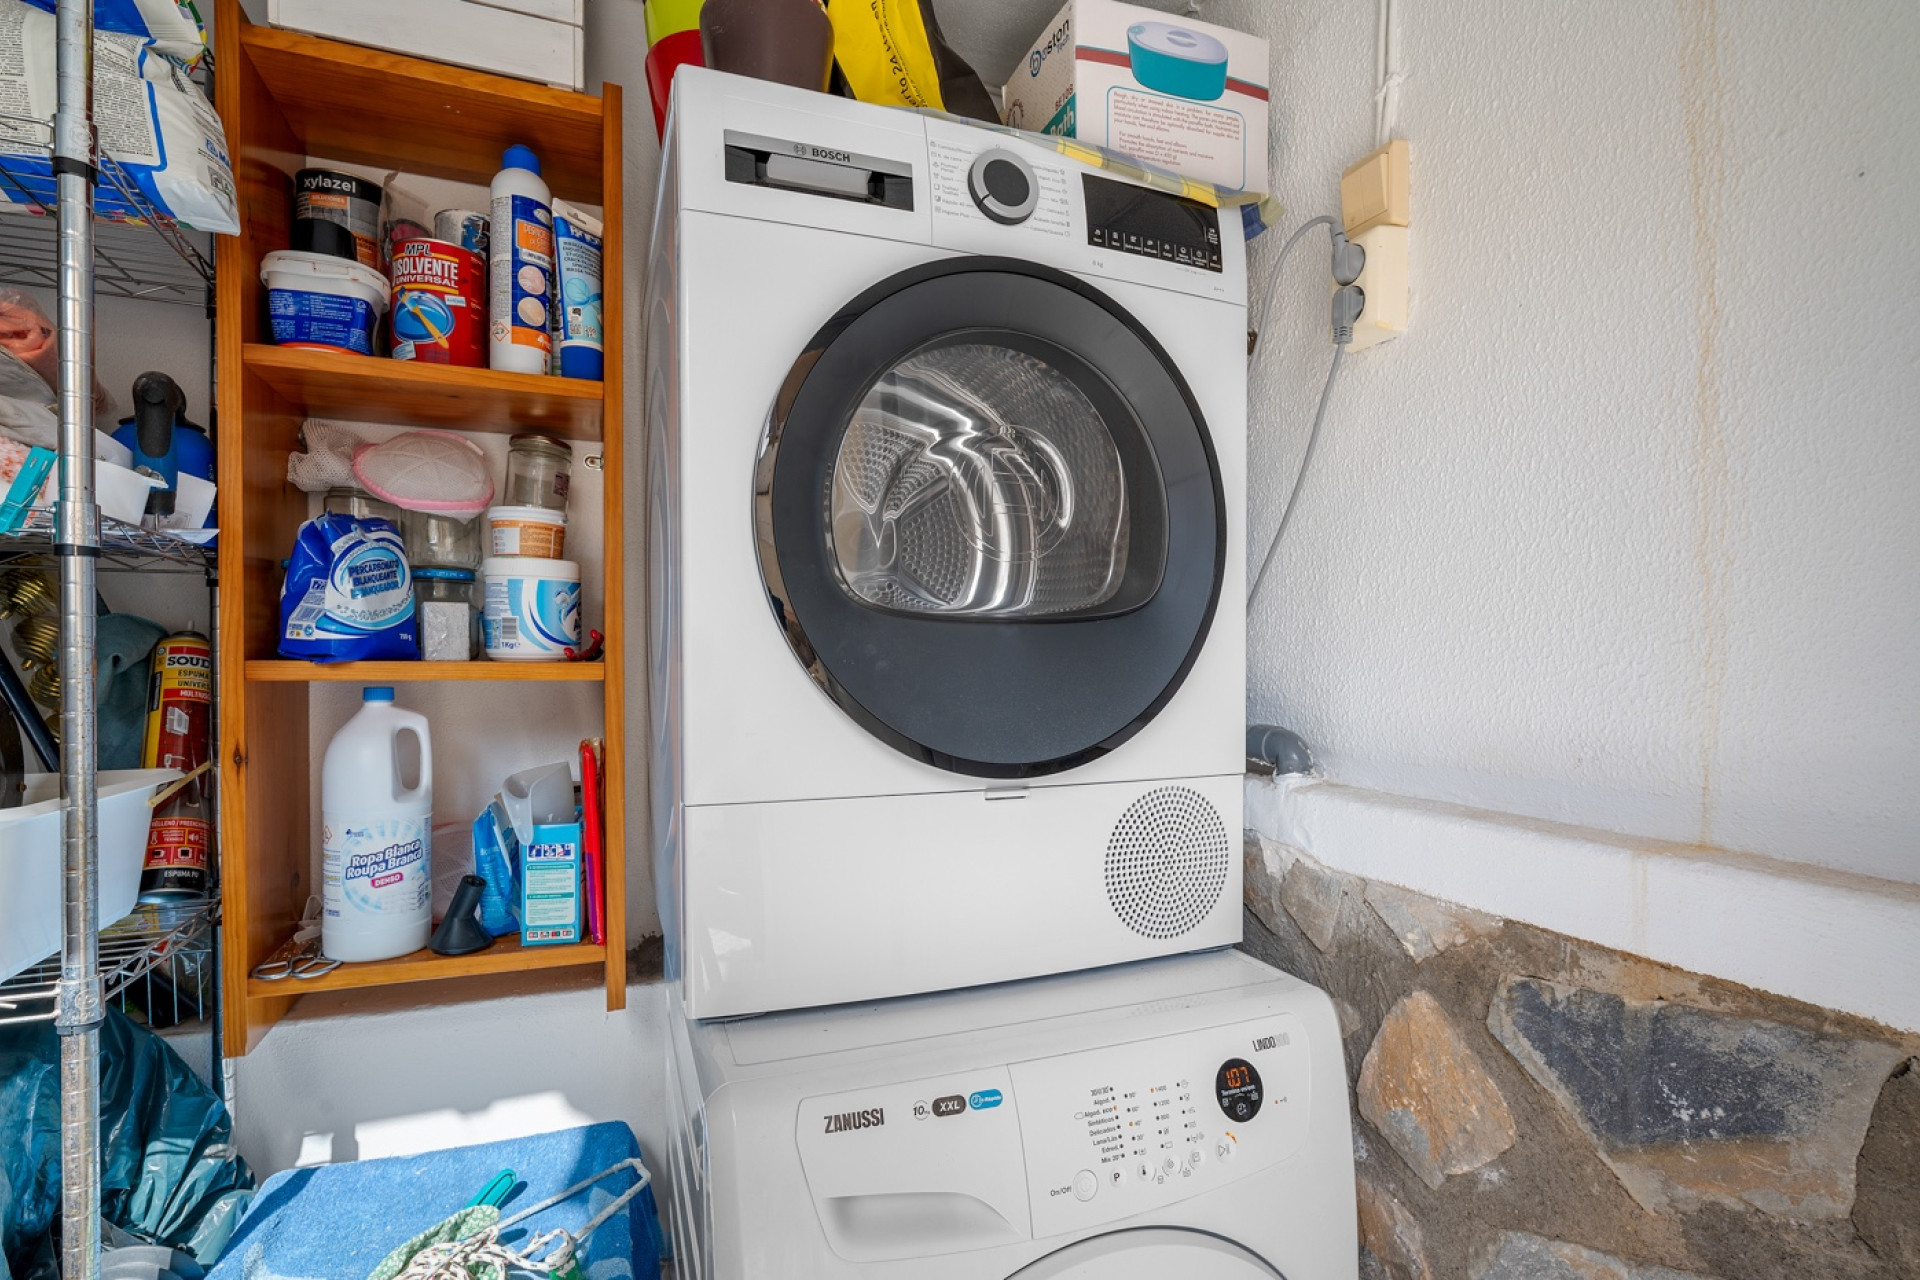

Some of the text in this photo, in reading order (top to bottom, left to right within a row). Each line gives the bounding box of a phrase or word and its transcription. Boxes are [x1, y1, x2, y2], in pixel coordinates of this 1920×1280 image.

[890, 55, 902, 75] 24
[812, 148, 851, 162] BOSCH
[303, 175, 356, 193] xylazel
[404, 243, 432, 256] MPL
[393, 257, 459, 281] ISOLVENTE
[351, 838, 421, 868] Ropa Blanca
[346, 848, 423, 880] Roupa Branca
[164, 869, 190, 878] ESPUMA
[939, 1100, 960, 1112] XXL
[824, 1108, 885, 1133] ZANUSSI
[1113, 1172, 1121, 1182] P
